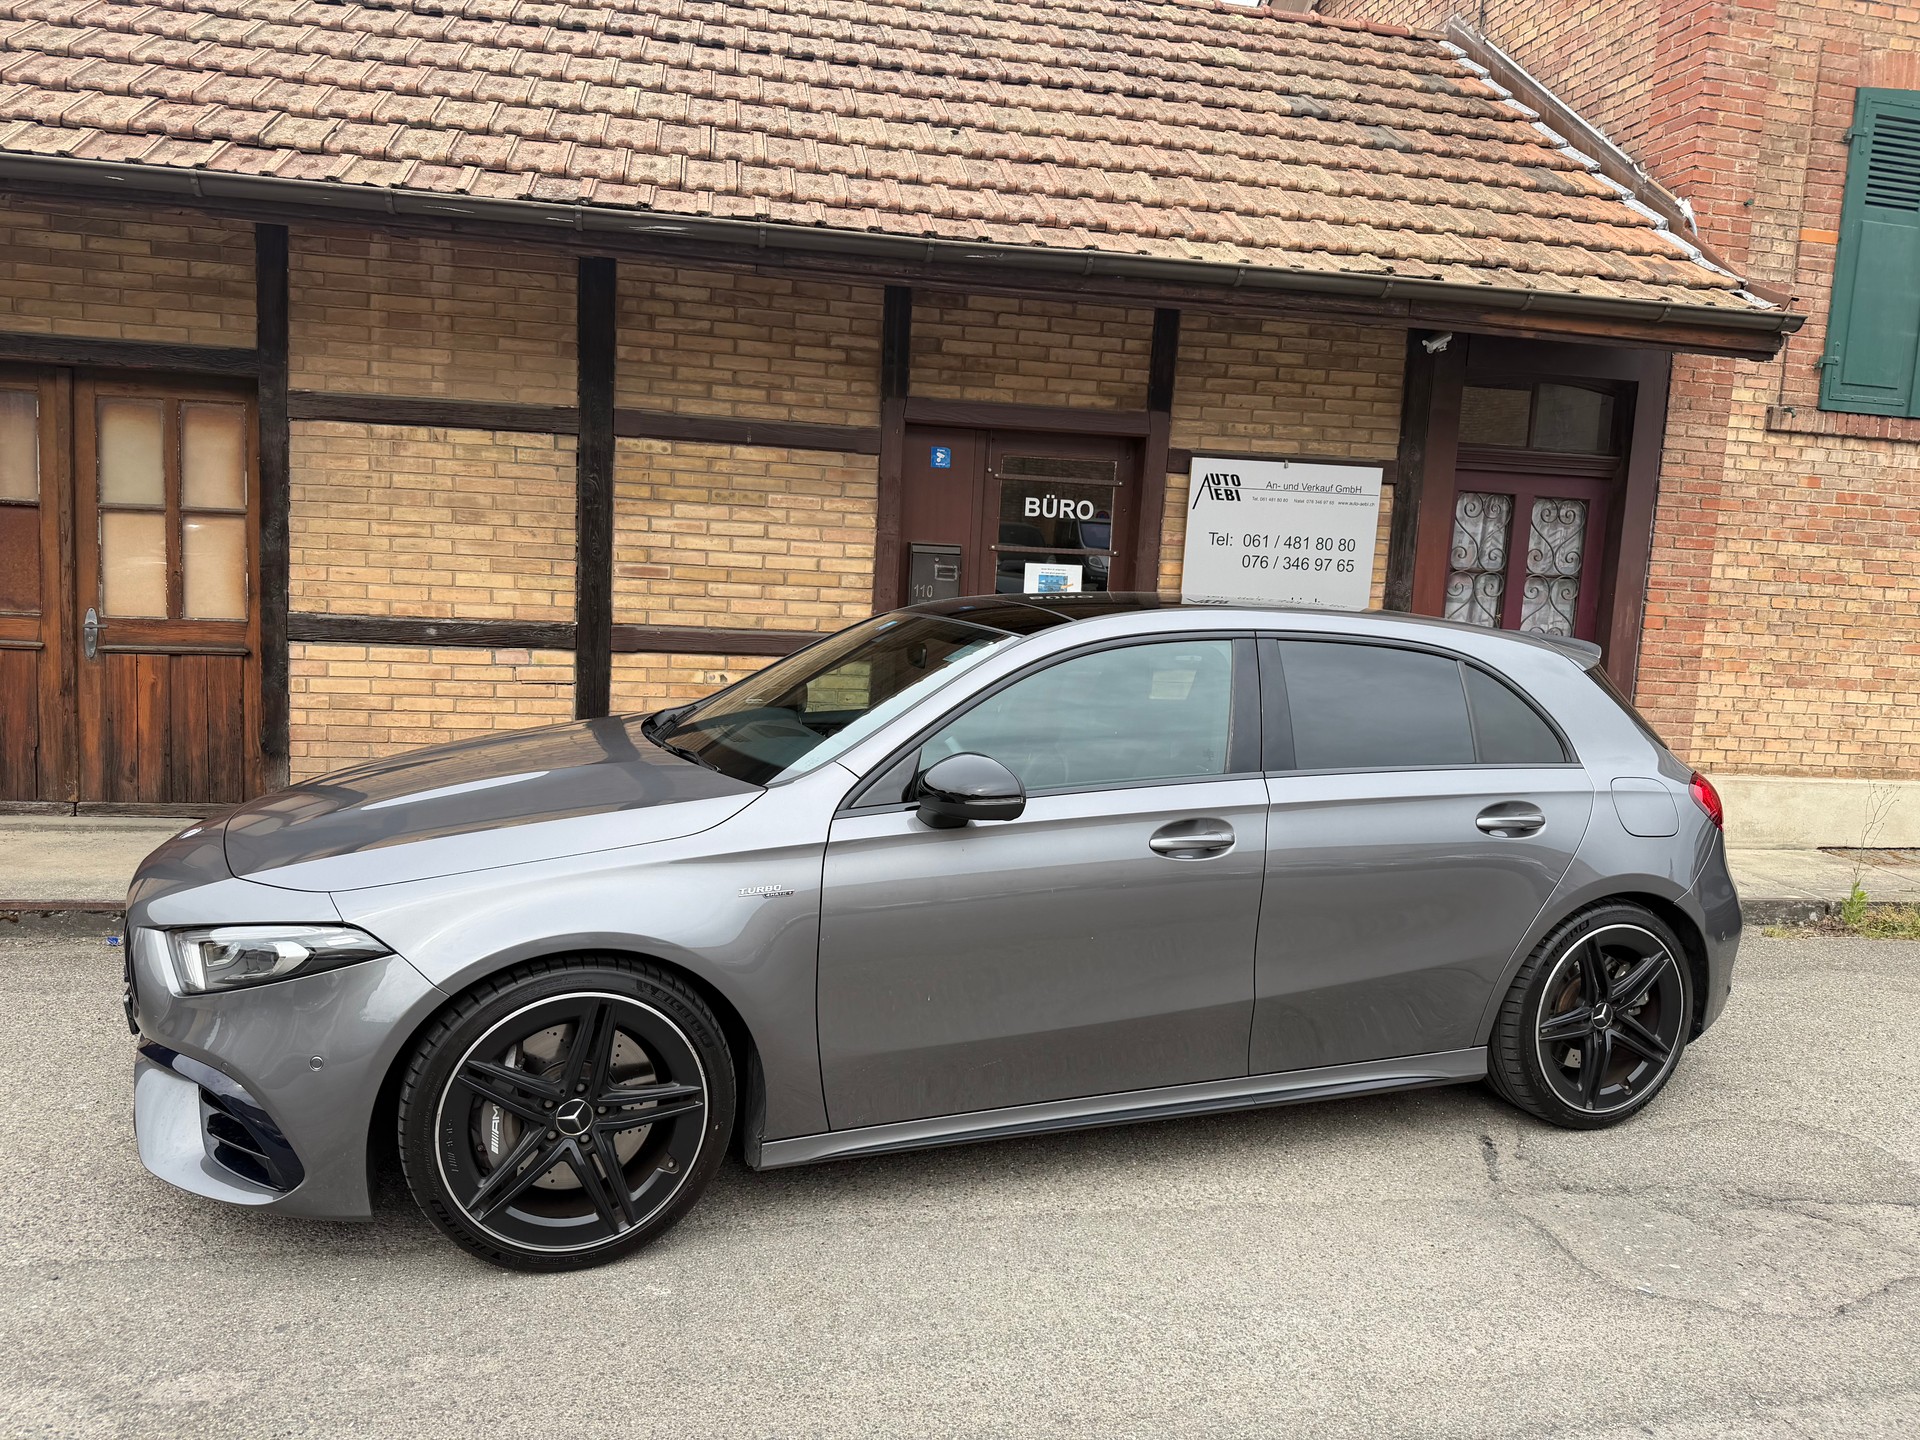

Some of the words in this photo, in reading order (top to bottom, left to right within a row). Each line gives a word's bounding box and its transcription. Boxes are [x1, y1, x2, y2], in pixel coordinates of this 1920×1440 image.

[1266, 481, 1281, 489] An-
[1283, 482, 1299, 491] und
[1302, 483, 1334, 492] Verkauf
[1335, 485, 1362, 494] GmbH
[1024, 494, 1094, 520] BÜRO
[1208, 532, 1233, 546] Tel:
[1242, 533, 1269, 548] 061
[1274, 535, 1280, 549] /
[1283, 535, 1310, 550] 481
[1315, 537, 1333, 551] 80
[1338, 538, 1356, 552] 80
[1241, 554, 1269, 569] 076
[1273, 556, 1279, 569] /
[1283, 556, 1310, 571] 346
[1314, 557, 1332, 572] 97
[1336, 559, 1355, 573] 65
[914, 584, 933, 598] 110
[739, 884, 782, 895] TURBO
